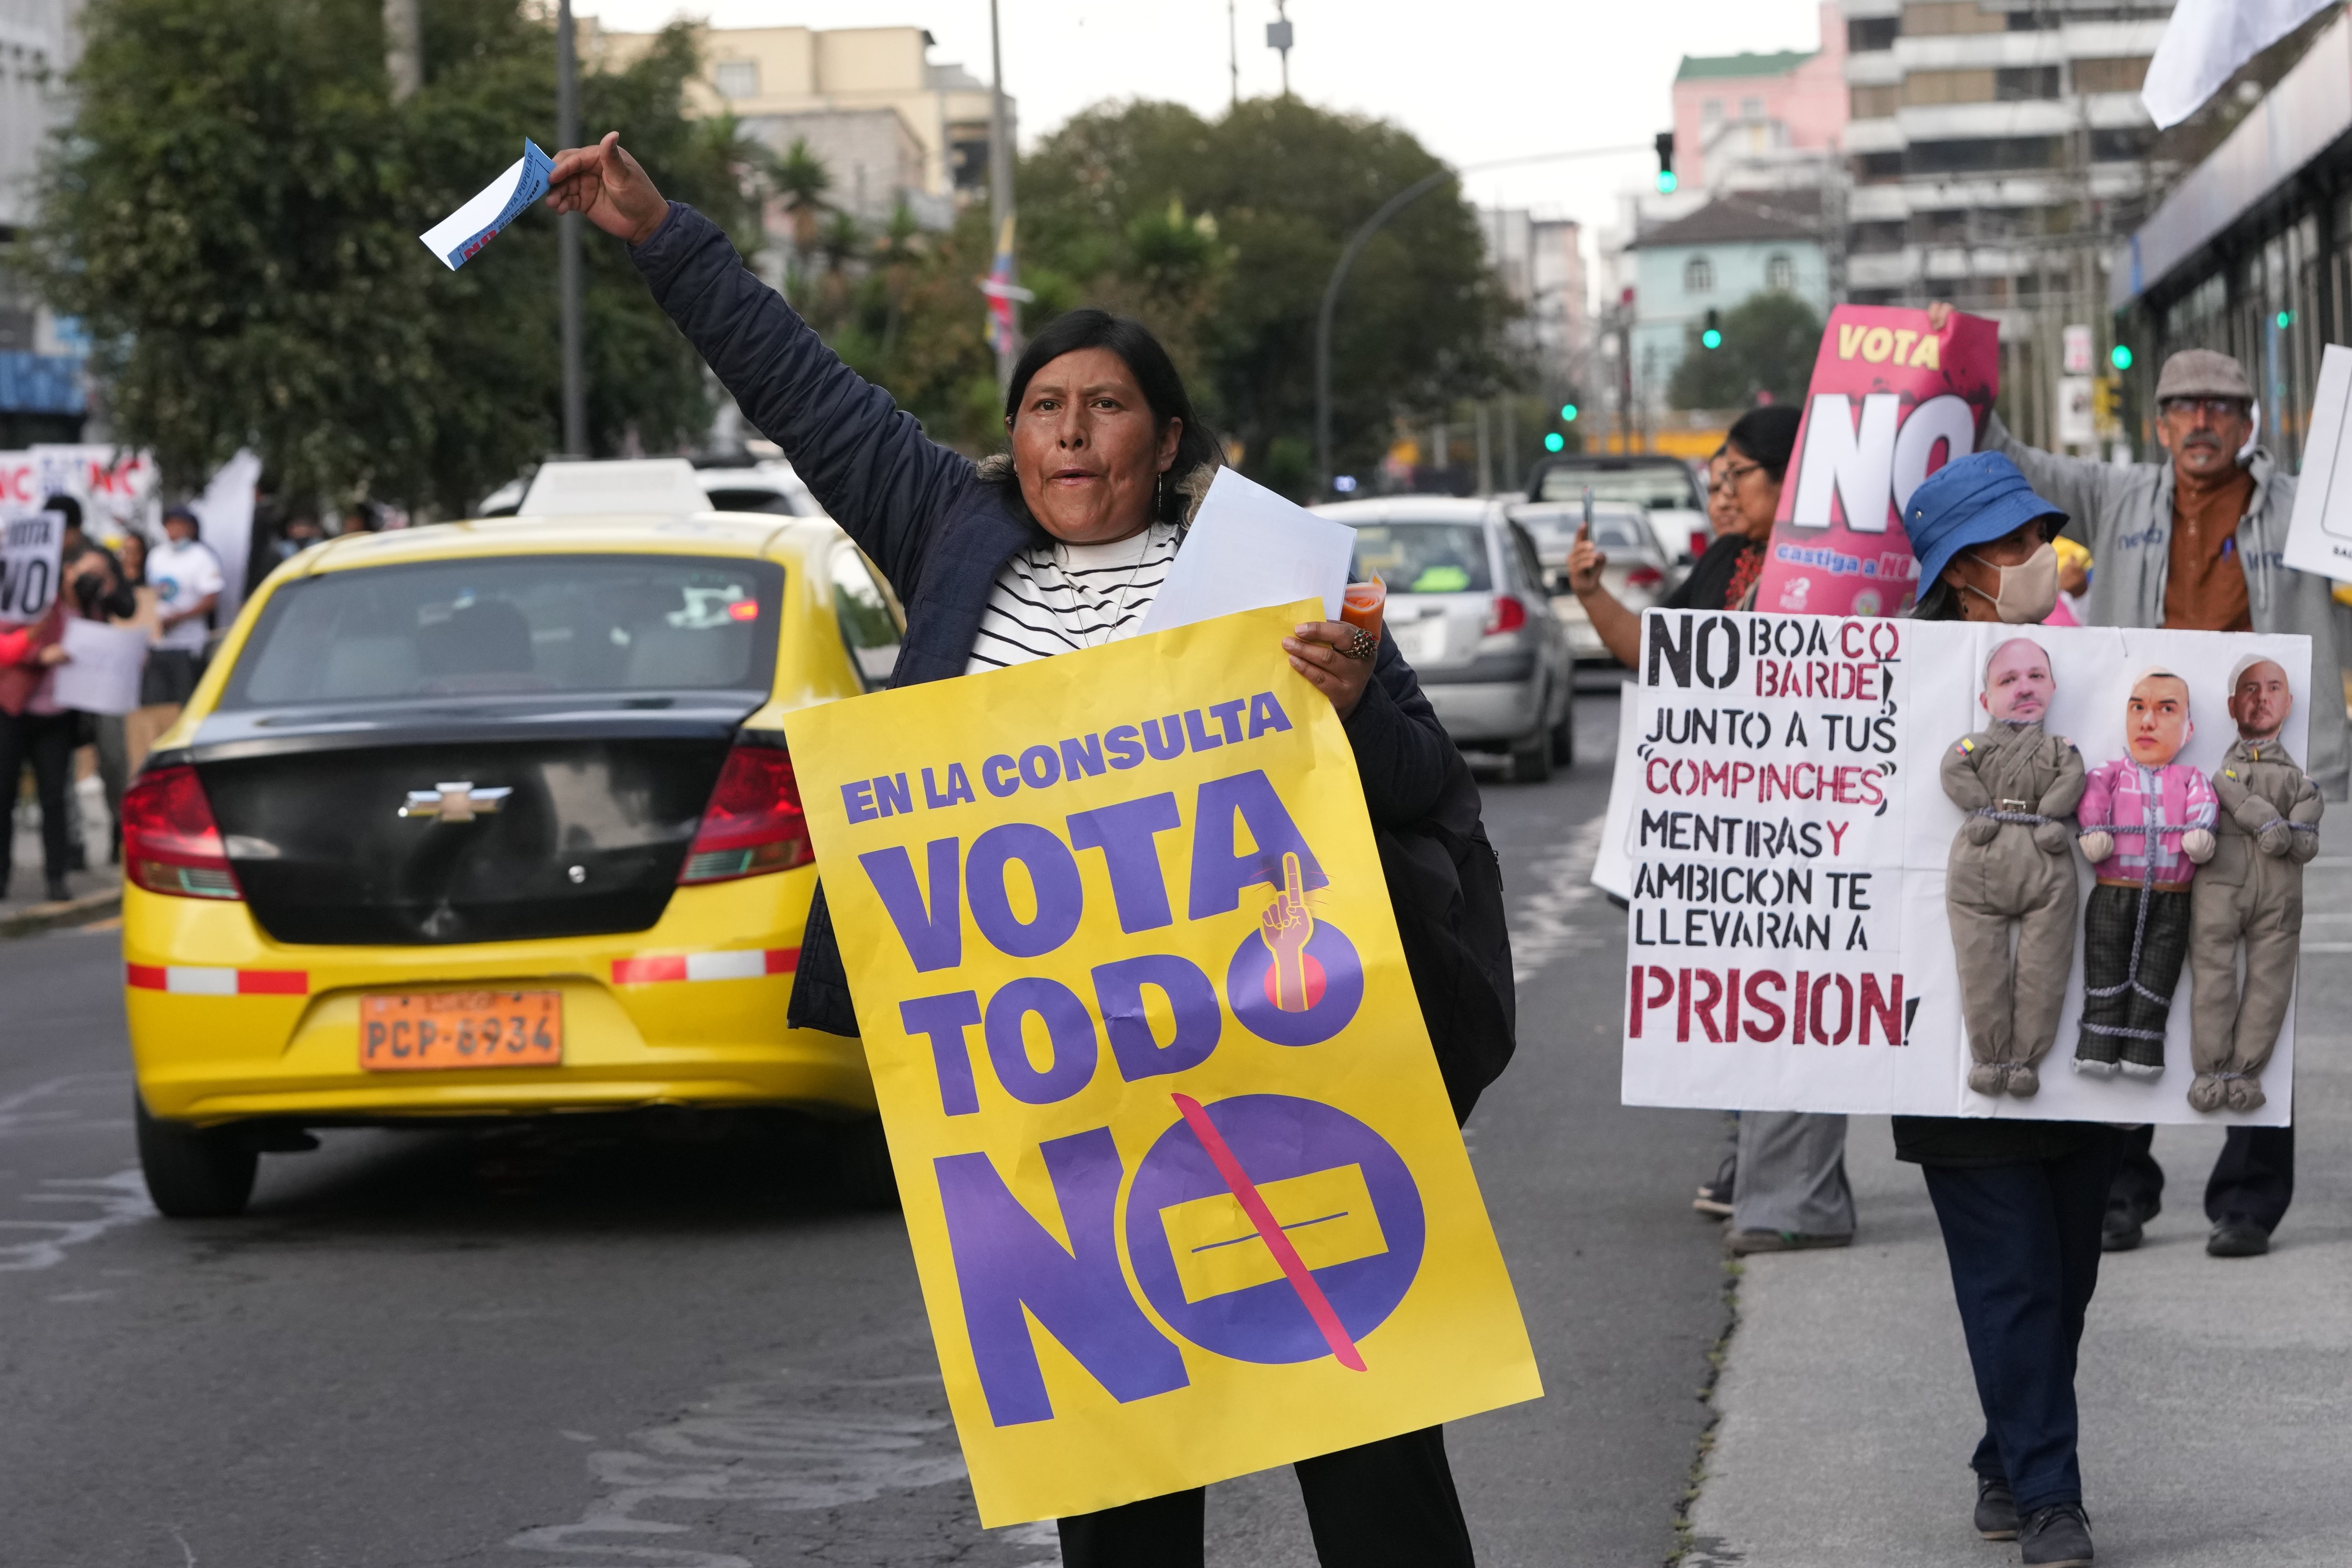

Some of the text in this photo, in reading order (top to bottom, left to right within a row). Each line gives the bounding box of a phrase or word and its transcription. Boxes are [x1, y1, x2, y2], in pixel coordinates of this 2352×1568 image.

[482, 197, 519, 233] CONSULTA
[517, 151, 534, 196] POPULAR
[463, 229, 497, 260] NO
[1838, 323, 1940, 371] VOTA
[1791, 393, 1976, 534] NO
[1647, 614, 1741, 689] NO
[1749, 618, 1829, 657] BOA
[840, 691, 1293, 825] EN LA CONSULTA
[1645, 708, 1897, 754] JUNTO A TUS
[857, 768, 1331, 973] VOTA
[1641, 808, 1849, 859] MENTIRAS Y
[1634, 862, 1872, 910] AMBICION TE
[1636, 908, 1868, 951] LLEVARAN A
[898, 916, 1364, 1117] TODO
[932, 1092, 1427, 1428] NO
